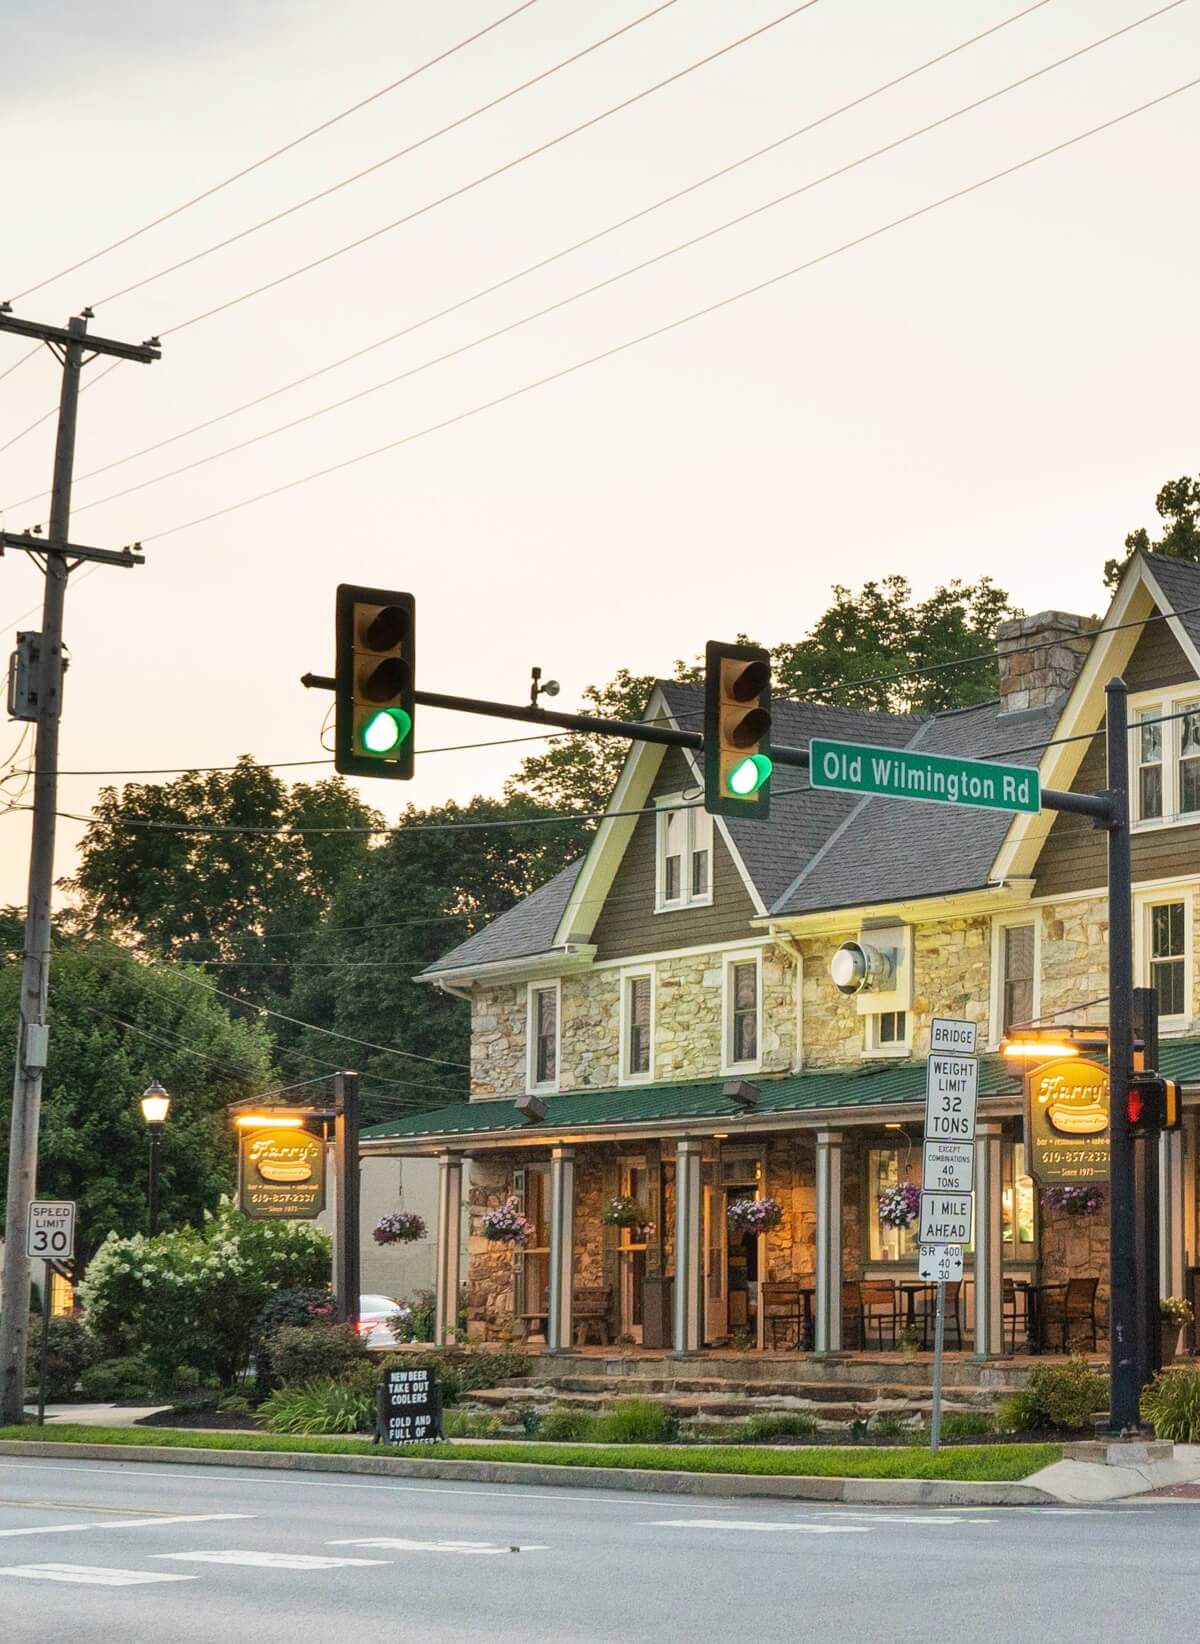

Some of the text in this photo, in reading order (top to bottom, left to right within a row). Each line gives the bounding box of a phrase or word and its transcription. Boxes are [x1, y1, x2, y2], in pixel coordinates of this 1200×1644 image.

[823, 751, 1030, 804] Old Wilmington Rd
[935, 1028, 973, 1044] BRIDGE
[934, 1062, 974, 1076] WEIGHT
[938, 1079, 967, 1092] LIMIT
[1038, 1075, 1110, 1104] Harry'
[942, 1096, 962, 1112] 32
[933, 1116, 969, 1133] TONS
[938, 1145, 961, 1154] EXCEPT
[928, 1154, 970, 1163] COMBINATIONS
[942, 1165, 954, 1175] 40
[937, 1178, 960, 1188] TONS
[33, 1207, 70, 1216] SPEED
[931, 1200, 967, 1216] 1 MILE
[35, 1219, 66, 1228] LIMIT
[926, 1224, 966, 1238] AHEAD
[33, 1231, 67, 1251] 30
[921, 1246, 936, 1256] SR
[938, 1258, 951, 1268] 40
[938, 1270, 949, 1280] 30
[390, 1370, 427, 1382] NEW BEER
[388, 1382, 429, 1393] TAKE OUT
[391, 1393, 428, 1405] COOLERS
[389, 1415, 431, 1428] COLD AND
[389, 1427, 426, 1439] FULL OF
